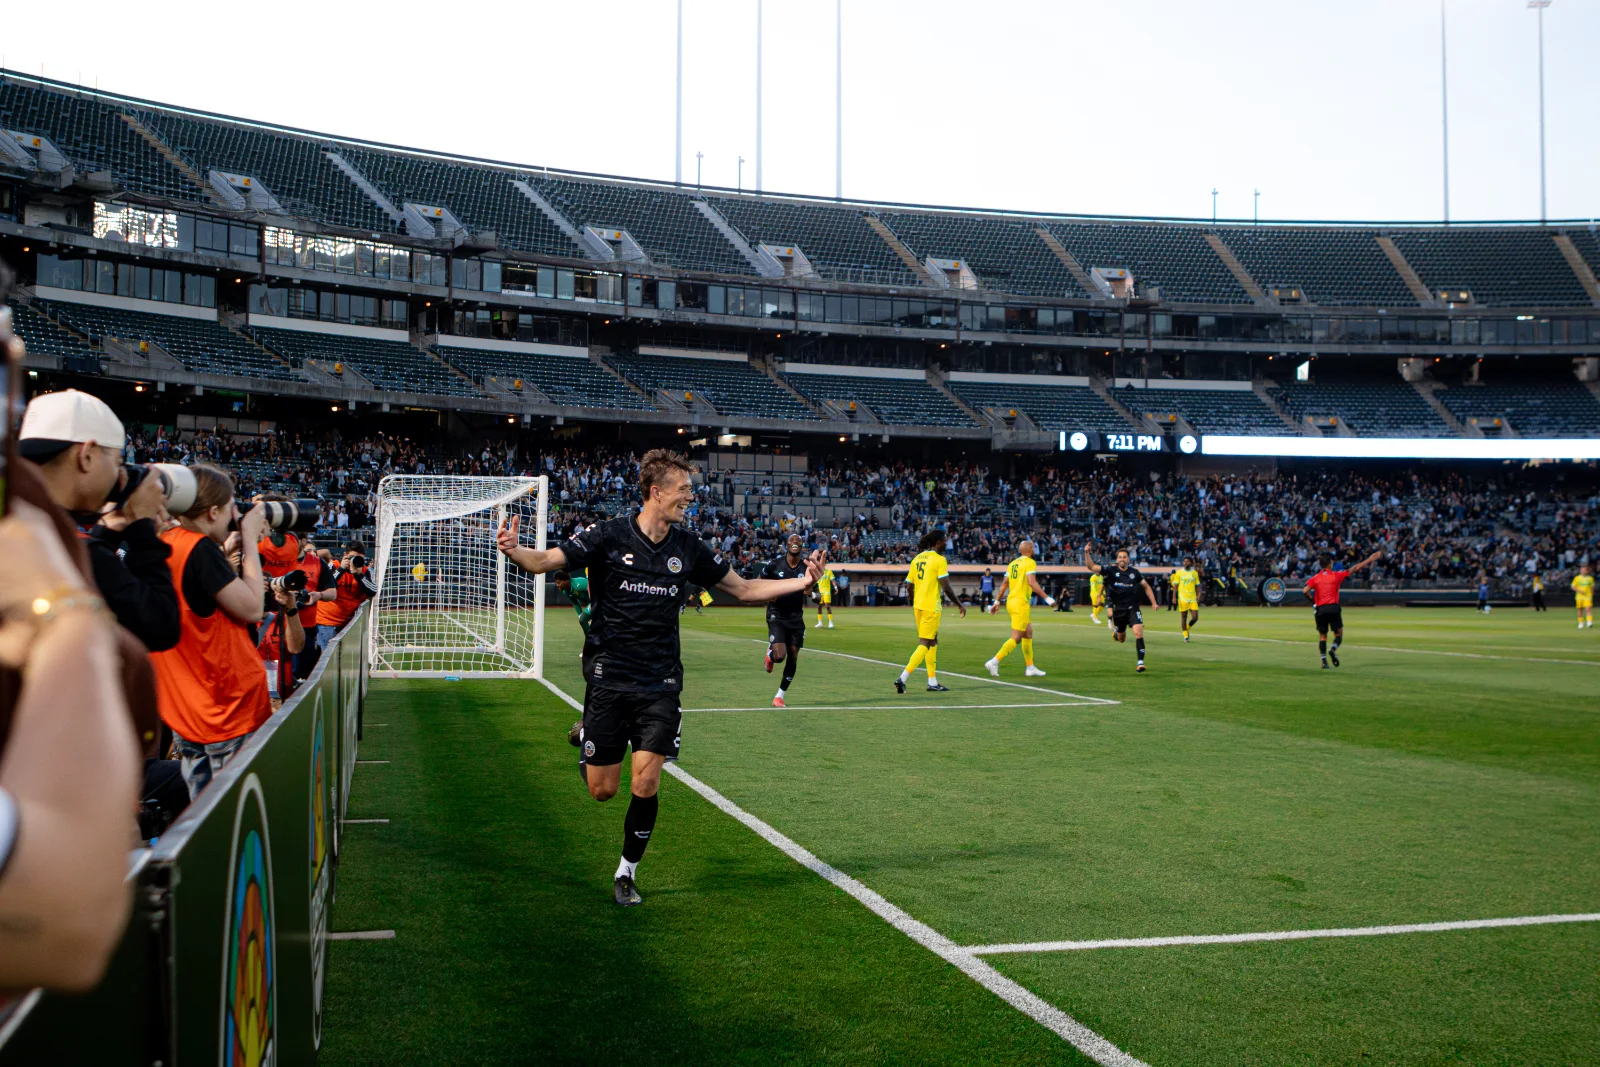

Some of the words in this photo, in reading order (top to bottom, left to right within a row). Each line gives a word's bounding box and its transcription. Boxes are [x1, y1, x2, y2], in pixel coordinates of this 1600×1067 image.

[1107, 434, 1134, 450] 7:11
[1137, 435, 1161, 451] PM
[266, 560, 291, 568] HARLY
[916, 561, 926, 580] 15
[1010, 563, 1019, 580] 16
[619, 579, 668, 597] Anthem
